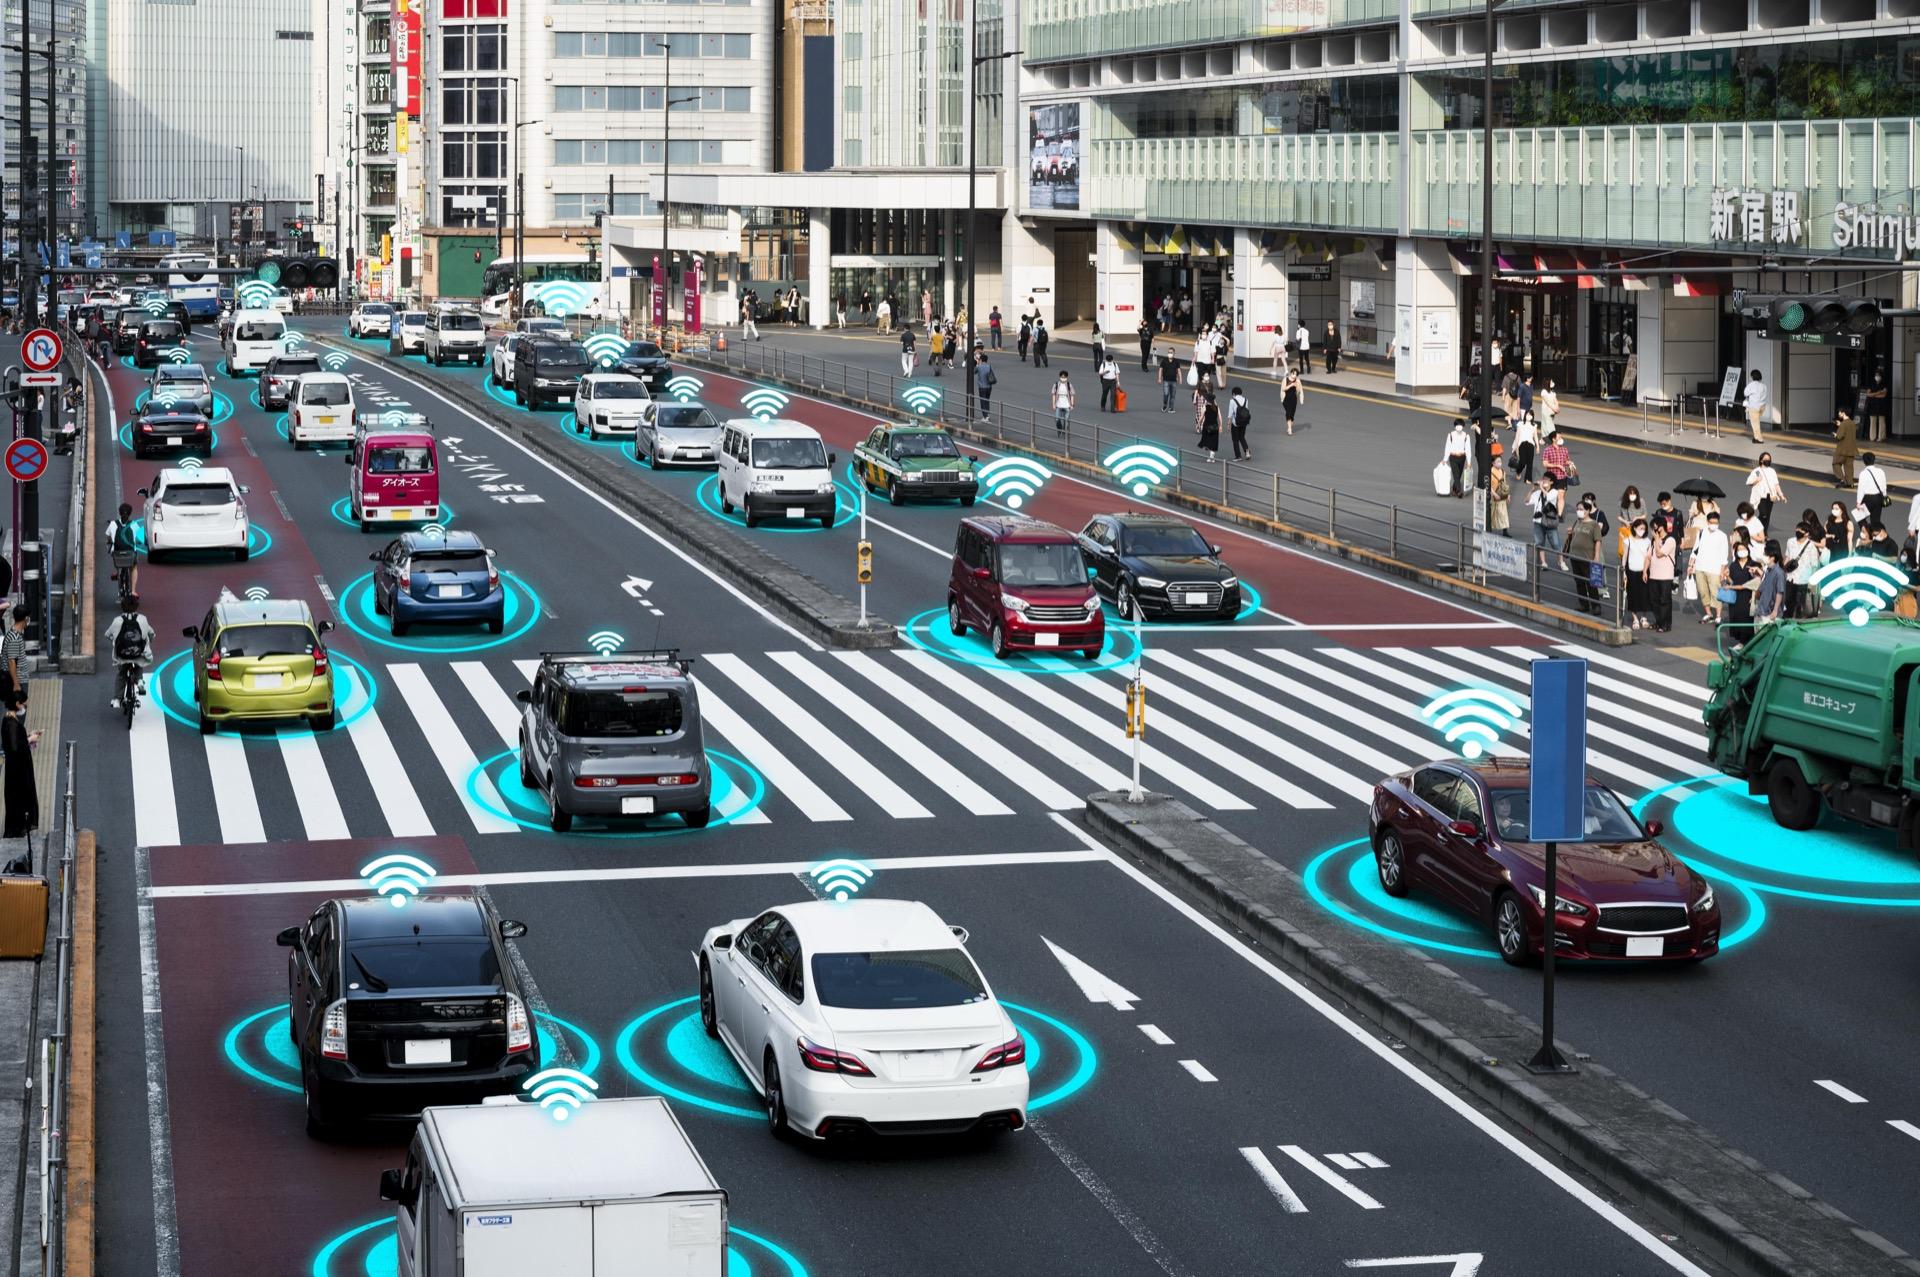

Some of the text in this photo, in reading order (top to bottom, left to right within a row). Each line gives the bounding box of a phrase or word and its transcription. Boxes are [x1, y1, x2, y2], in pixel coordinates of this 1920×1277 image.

[1711, 187, 1802, 244] 新宿駅
[382, 478, 420, 487] ダイオーズ
